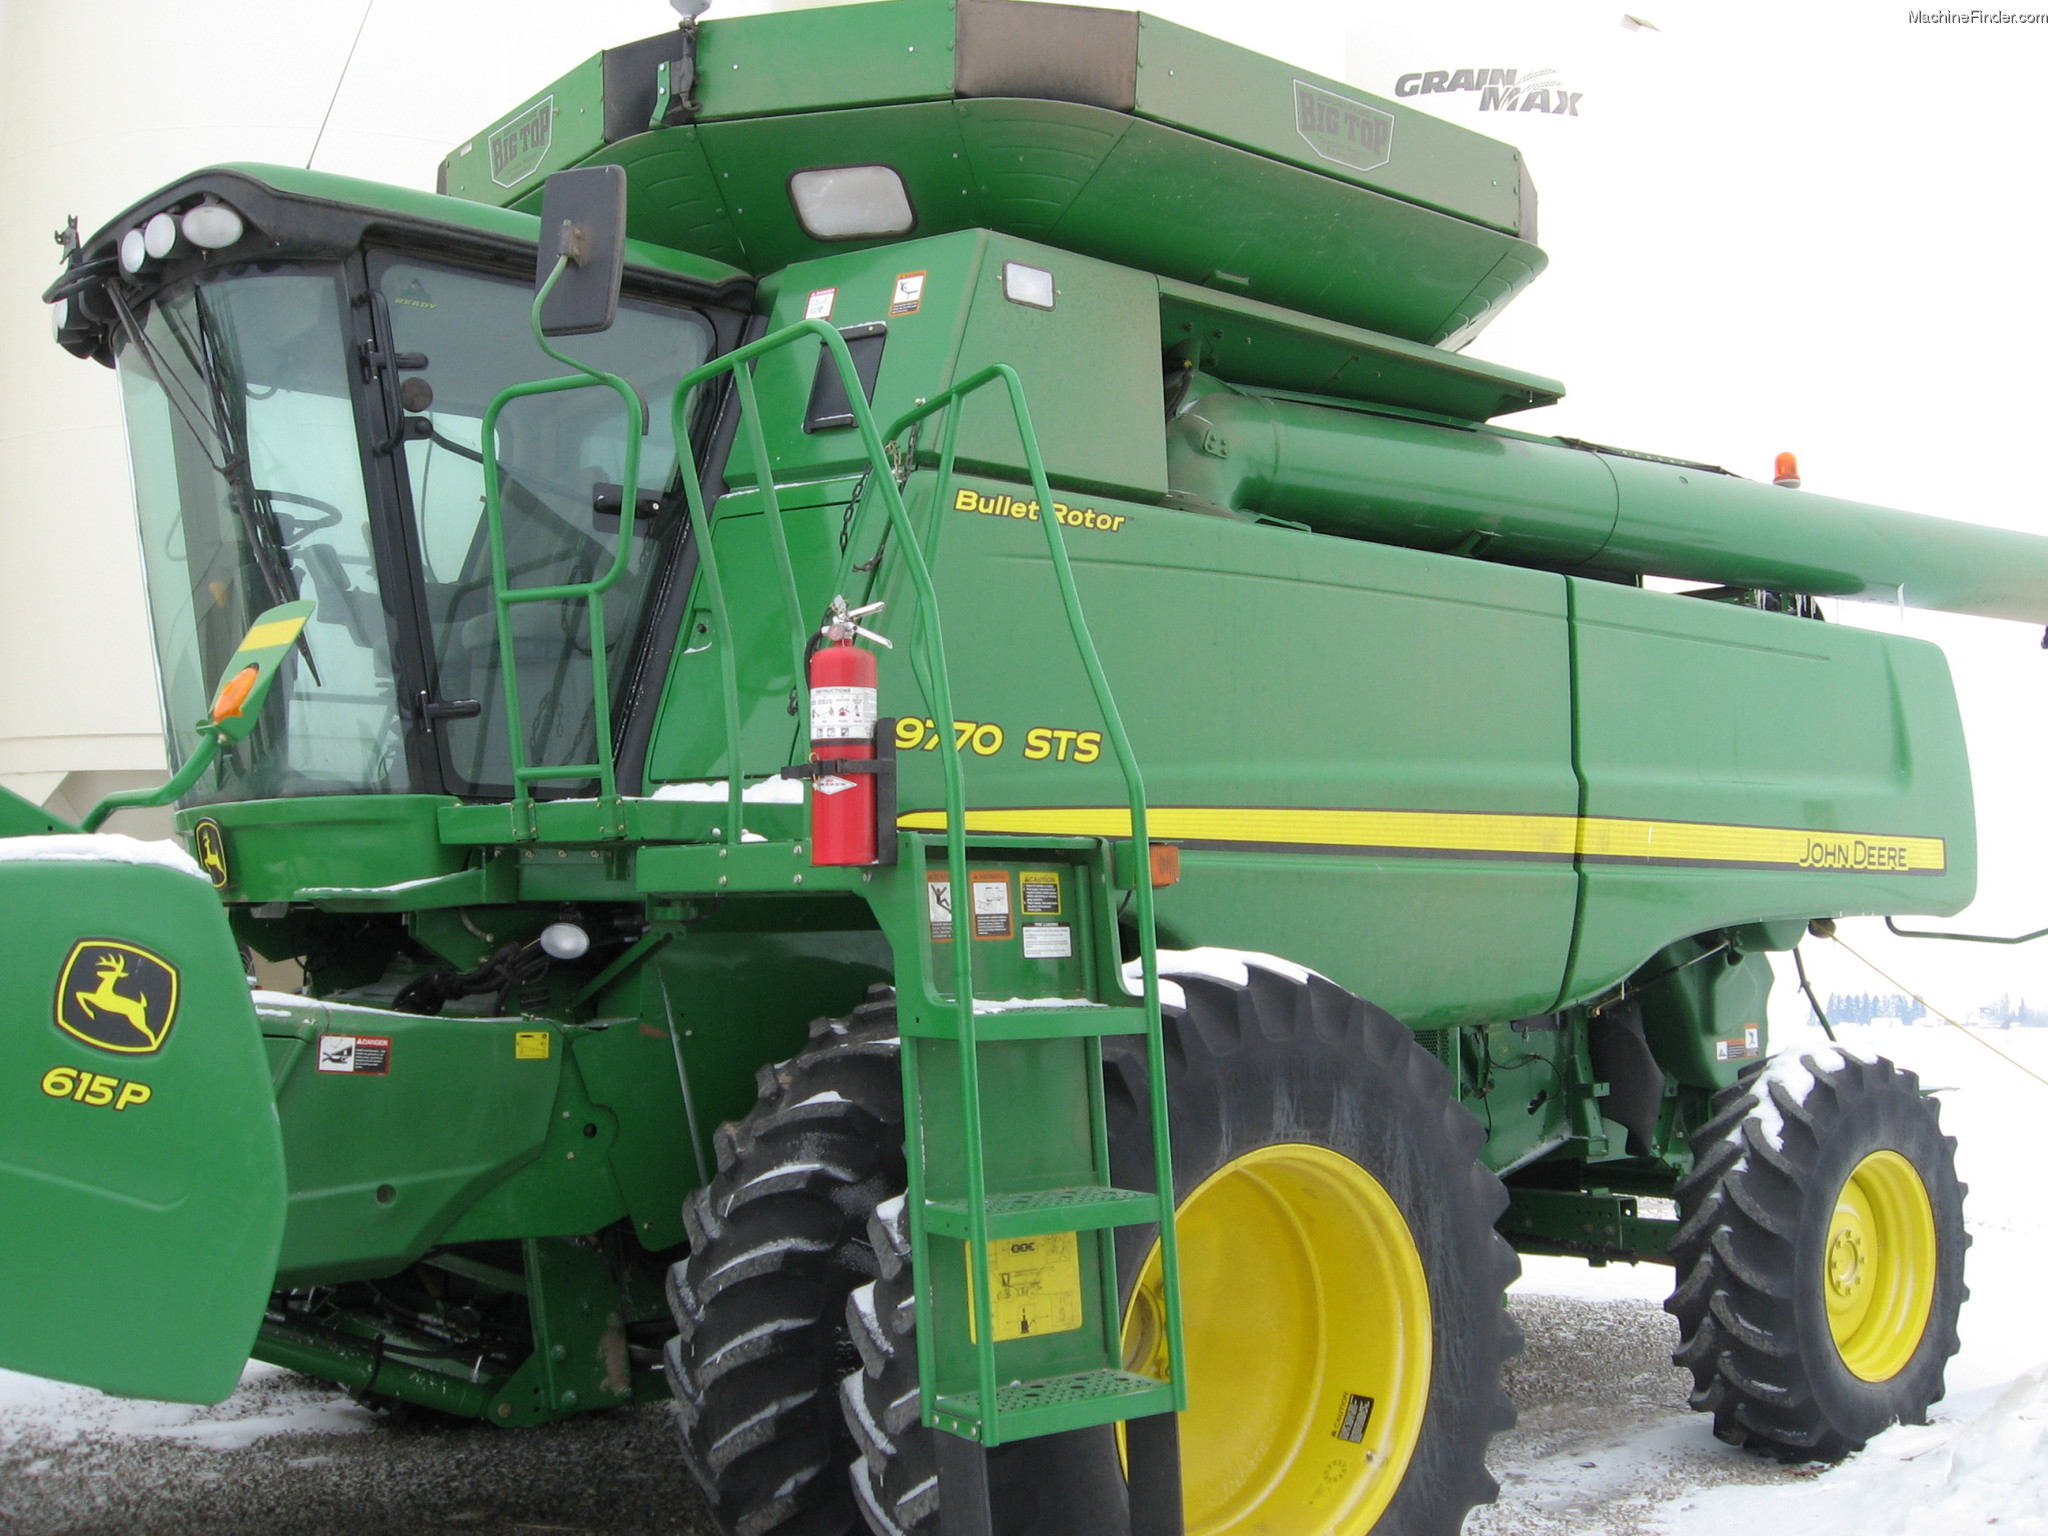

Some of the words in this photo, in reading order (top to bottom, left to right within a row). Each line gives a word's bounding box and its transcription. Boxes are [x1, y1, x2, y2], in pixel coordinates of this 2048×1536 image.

[1395, 68, 1518, 97] GRAIN
[1478, 87, 1584, 117] MAX
[492, 131, 518, 178] BIG
[520, 104, 550, 153] TOP
[1299, 89, 1340, 136] BIG
[1344, 115, 1389, 156] TOP
[954, 488, 1041, 521] Bullet
[1052, 502, 1127, 533] Rotor
[1023, 727, 1103, 764] STS
[1799, 838, 1850, 865] JOHN
[1853, 840, 1908, 867] DEERE
[41, 1065, 153, 1112] 615P
[1334, 1391, 1349, 1429] CAUTION
